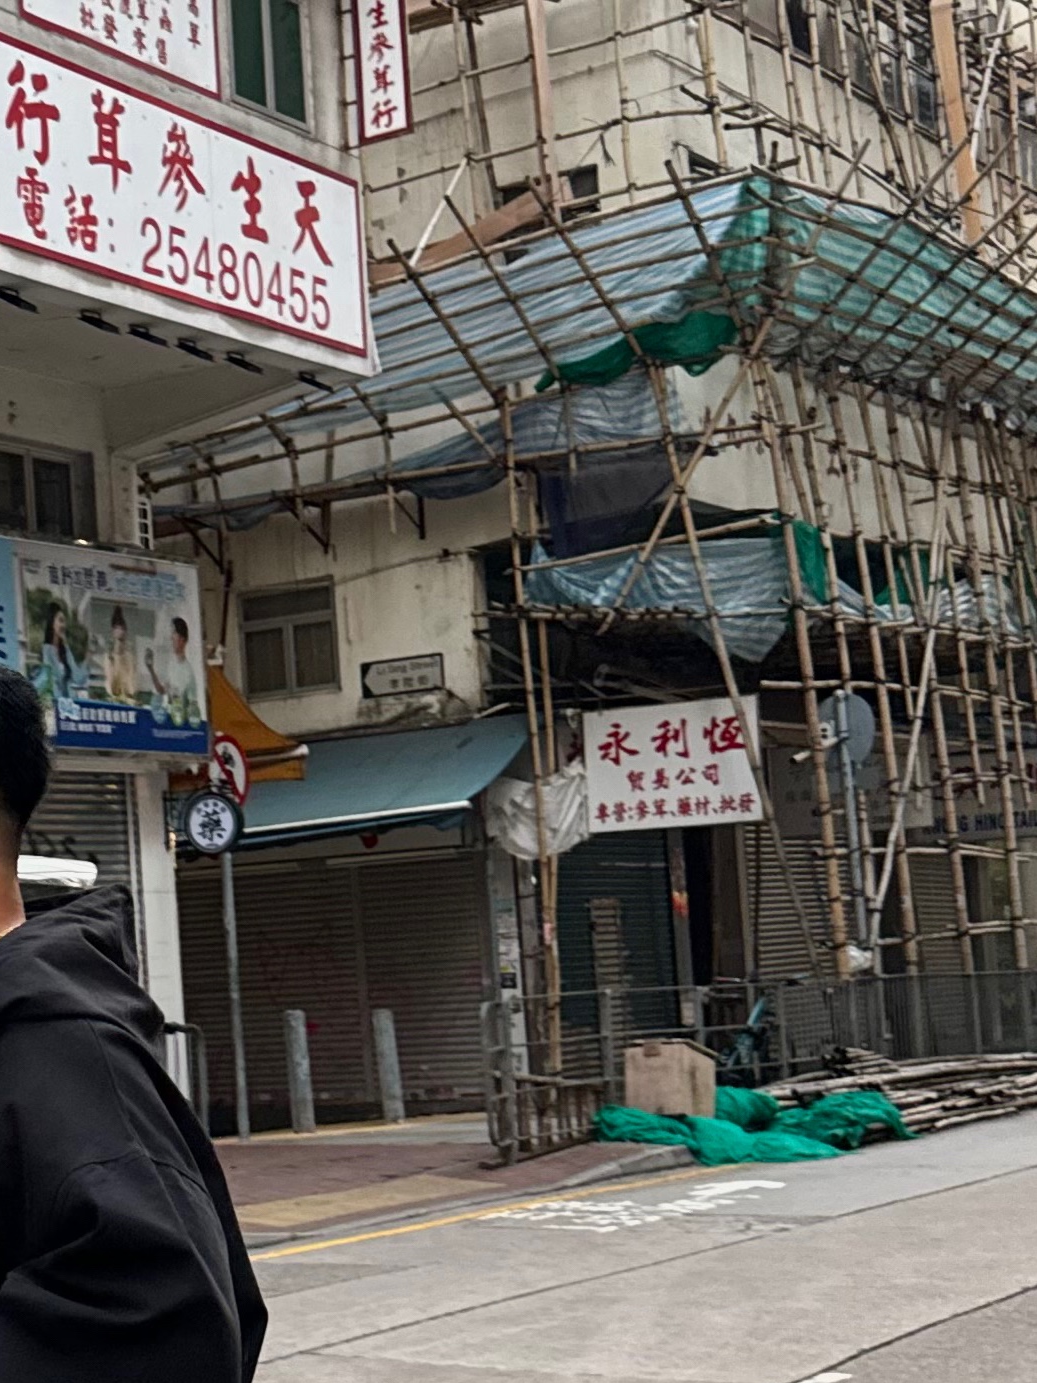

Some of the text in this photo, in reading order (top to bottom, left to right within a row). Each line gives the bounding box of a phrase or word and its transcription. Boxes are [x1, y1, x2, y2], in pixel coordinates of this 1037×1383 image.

[140, 216, 331, 331] 25480455
[626, 763, 720, 792] 貿易公司
